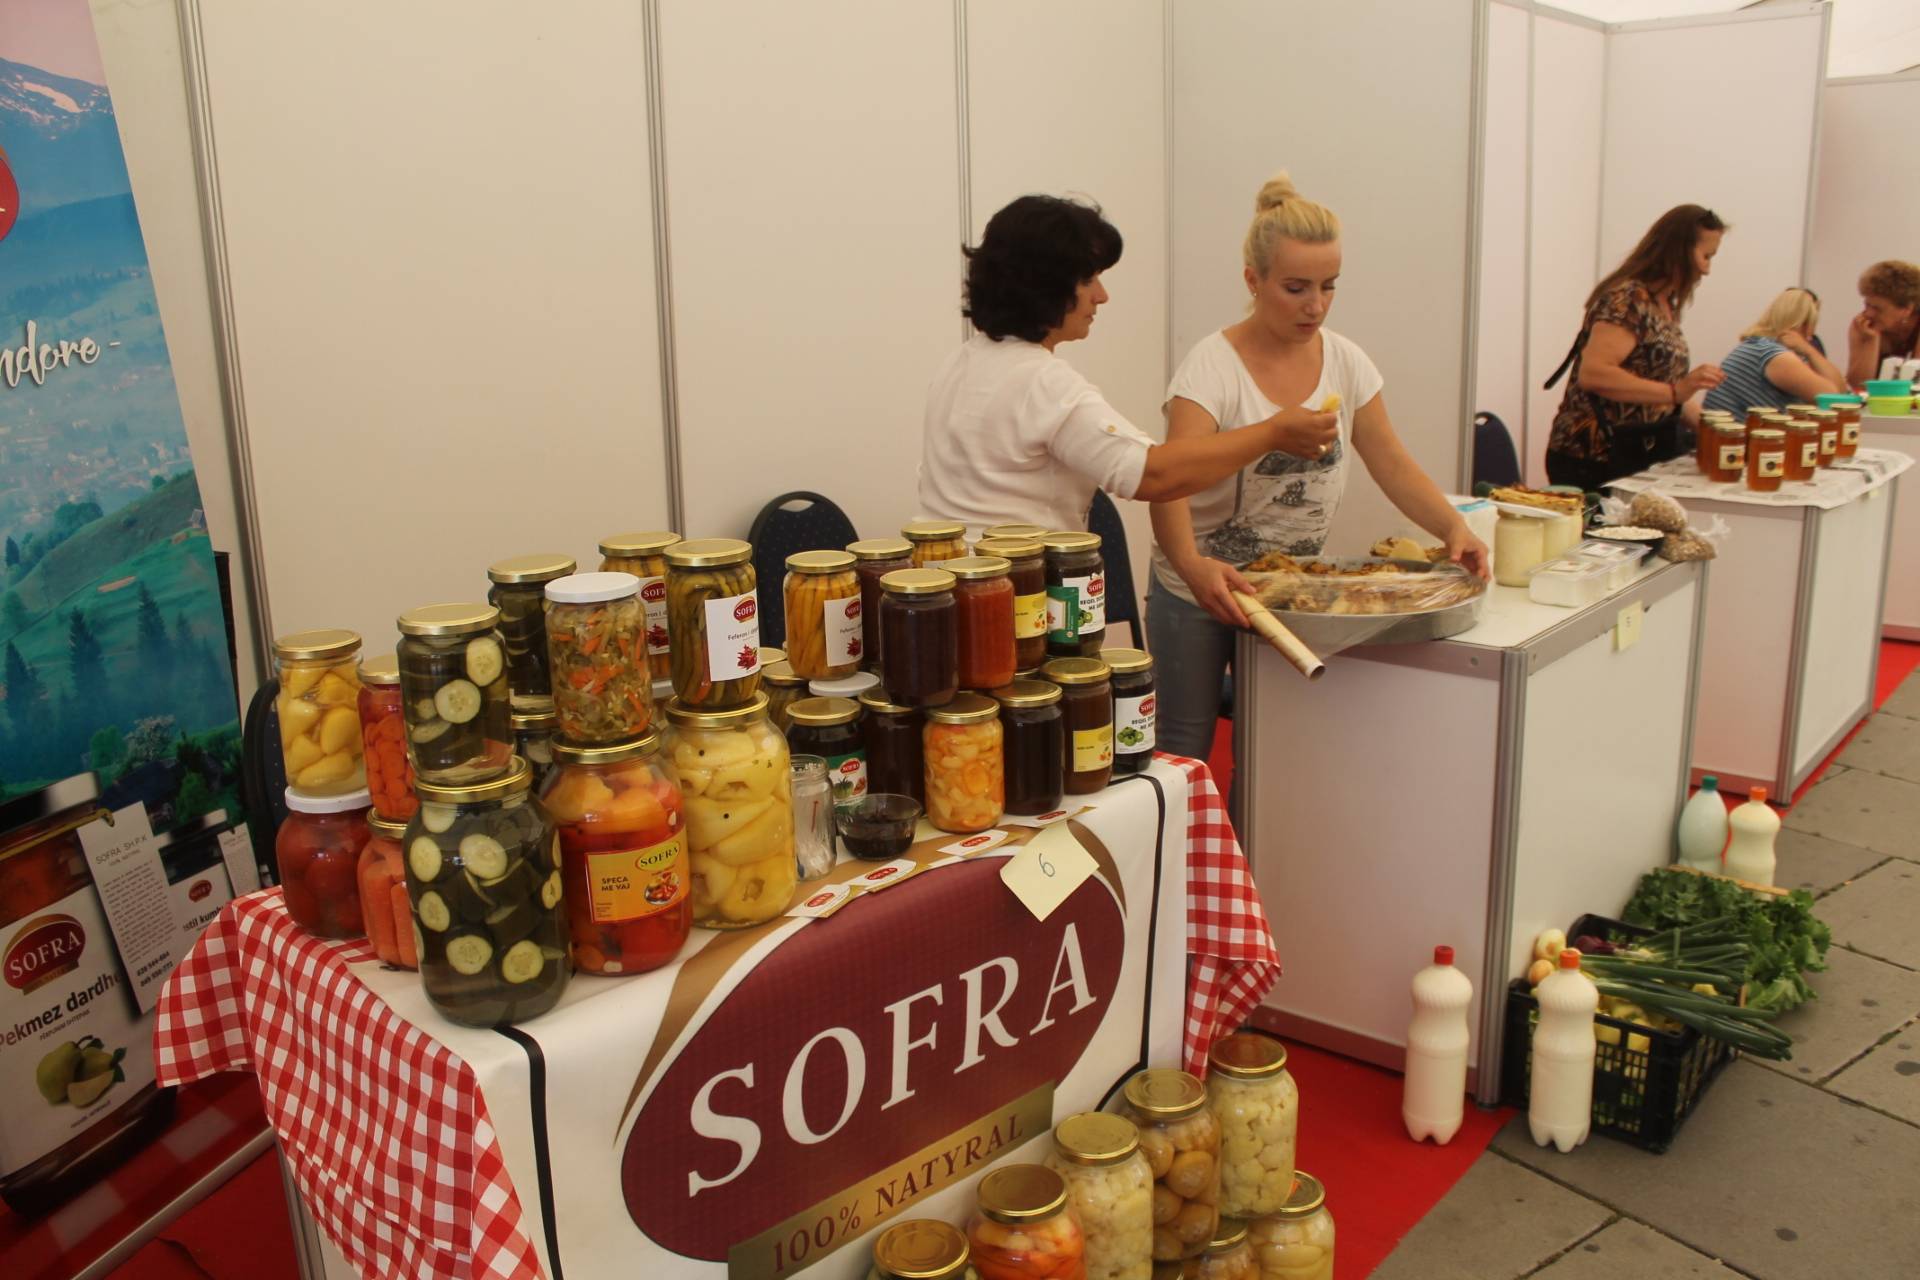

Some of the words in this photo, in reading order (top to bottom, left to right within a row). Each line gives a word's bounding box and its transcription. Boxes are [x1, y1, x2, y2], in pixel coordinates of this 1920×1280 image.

[601, 876, 629, 885] SPECA
[1038, 852, 1057, 878] 6
[616, 883, 631, 891] VAJ
[9, 930, 82, 979] SOFRA
[687, 921, 1098, 1198] SOFRA
[773, 1198, 862, 1273] 100%
[874, 1114, 1024, 1217] NATYRAL
